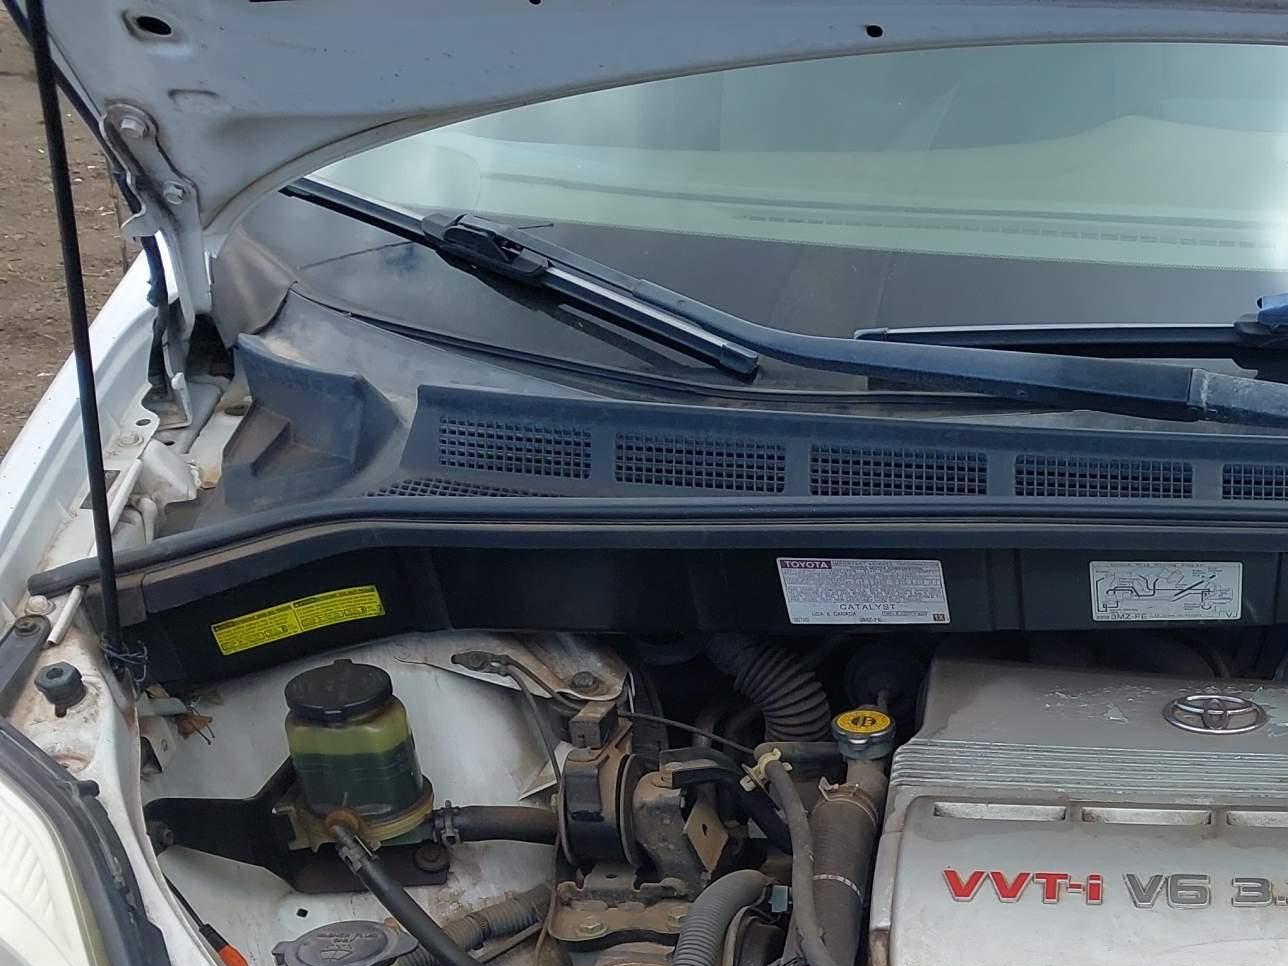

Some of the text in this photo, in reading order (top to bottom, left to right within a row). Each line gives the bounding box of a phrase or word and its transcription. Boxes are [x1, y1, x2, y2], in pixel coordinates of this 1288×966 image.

[783, 560, 829, 569] TOYOTA
[839, 603, 896, 611] CATALYST
[943, 869, 1103, 905] VVT-i
[1123, 873, 1212, 909] V6
